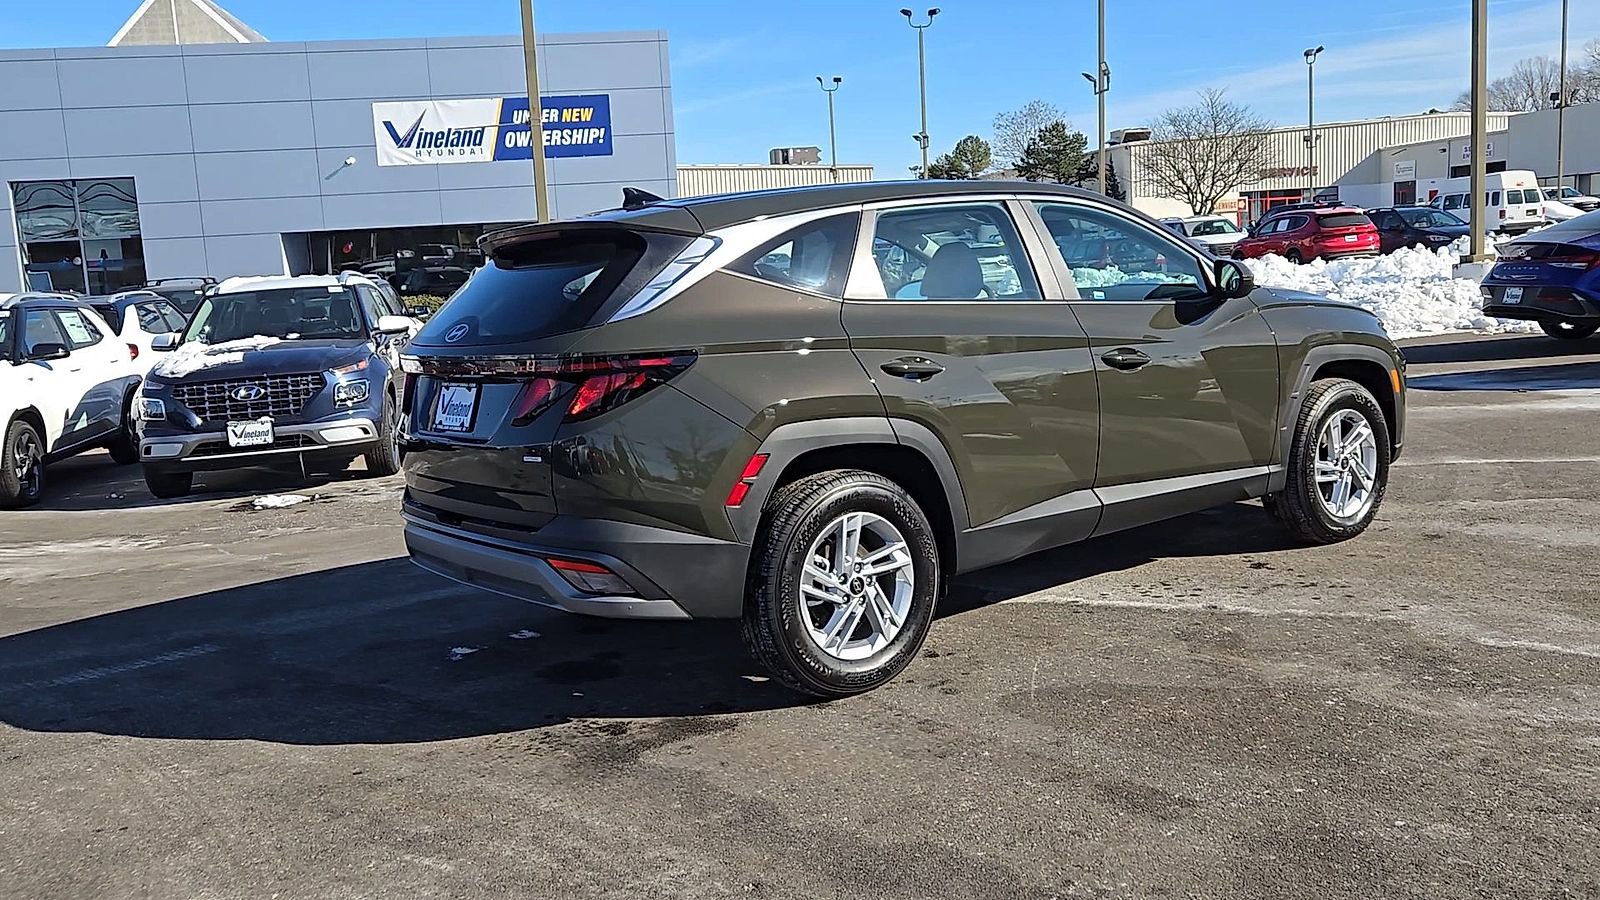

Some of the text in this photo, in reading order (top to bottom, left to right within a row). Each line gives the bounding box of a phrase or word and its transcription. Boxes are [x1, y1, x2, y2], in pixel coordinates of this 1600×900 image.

[512, 107, 593, 125] UNER NEW
[382, 108, 485, 149] Vineland
[504, 127, 605, 148] OWERSHIP!
[415, 148, 483, 157] HYUNDAI
[231, 426, 269, 439] Vineland
